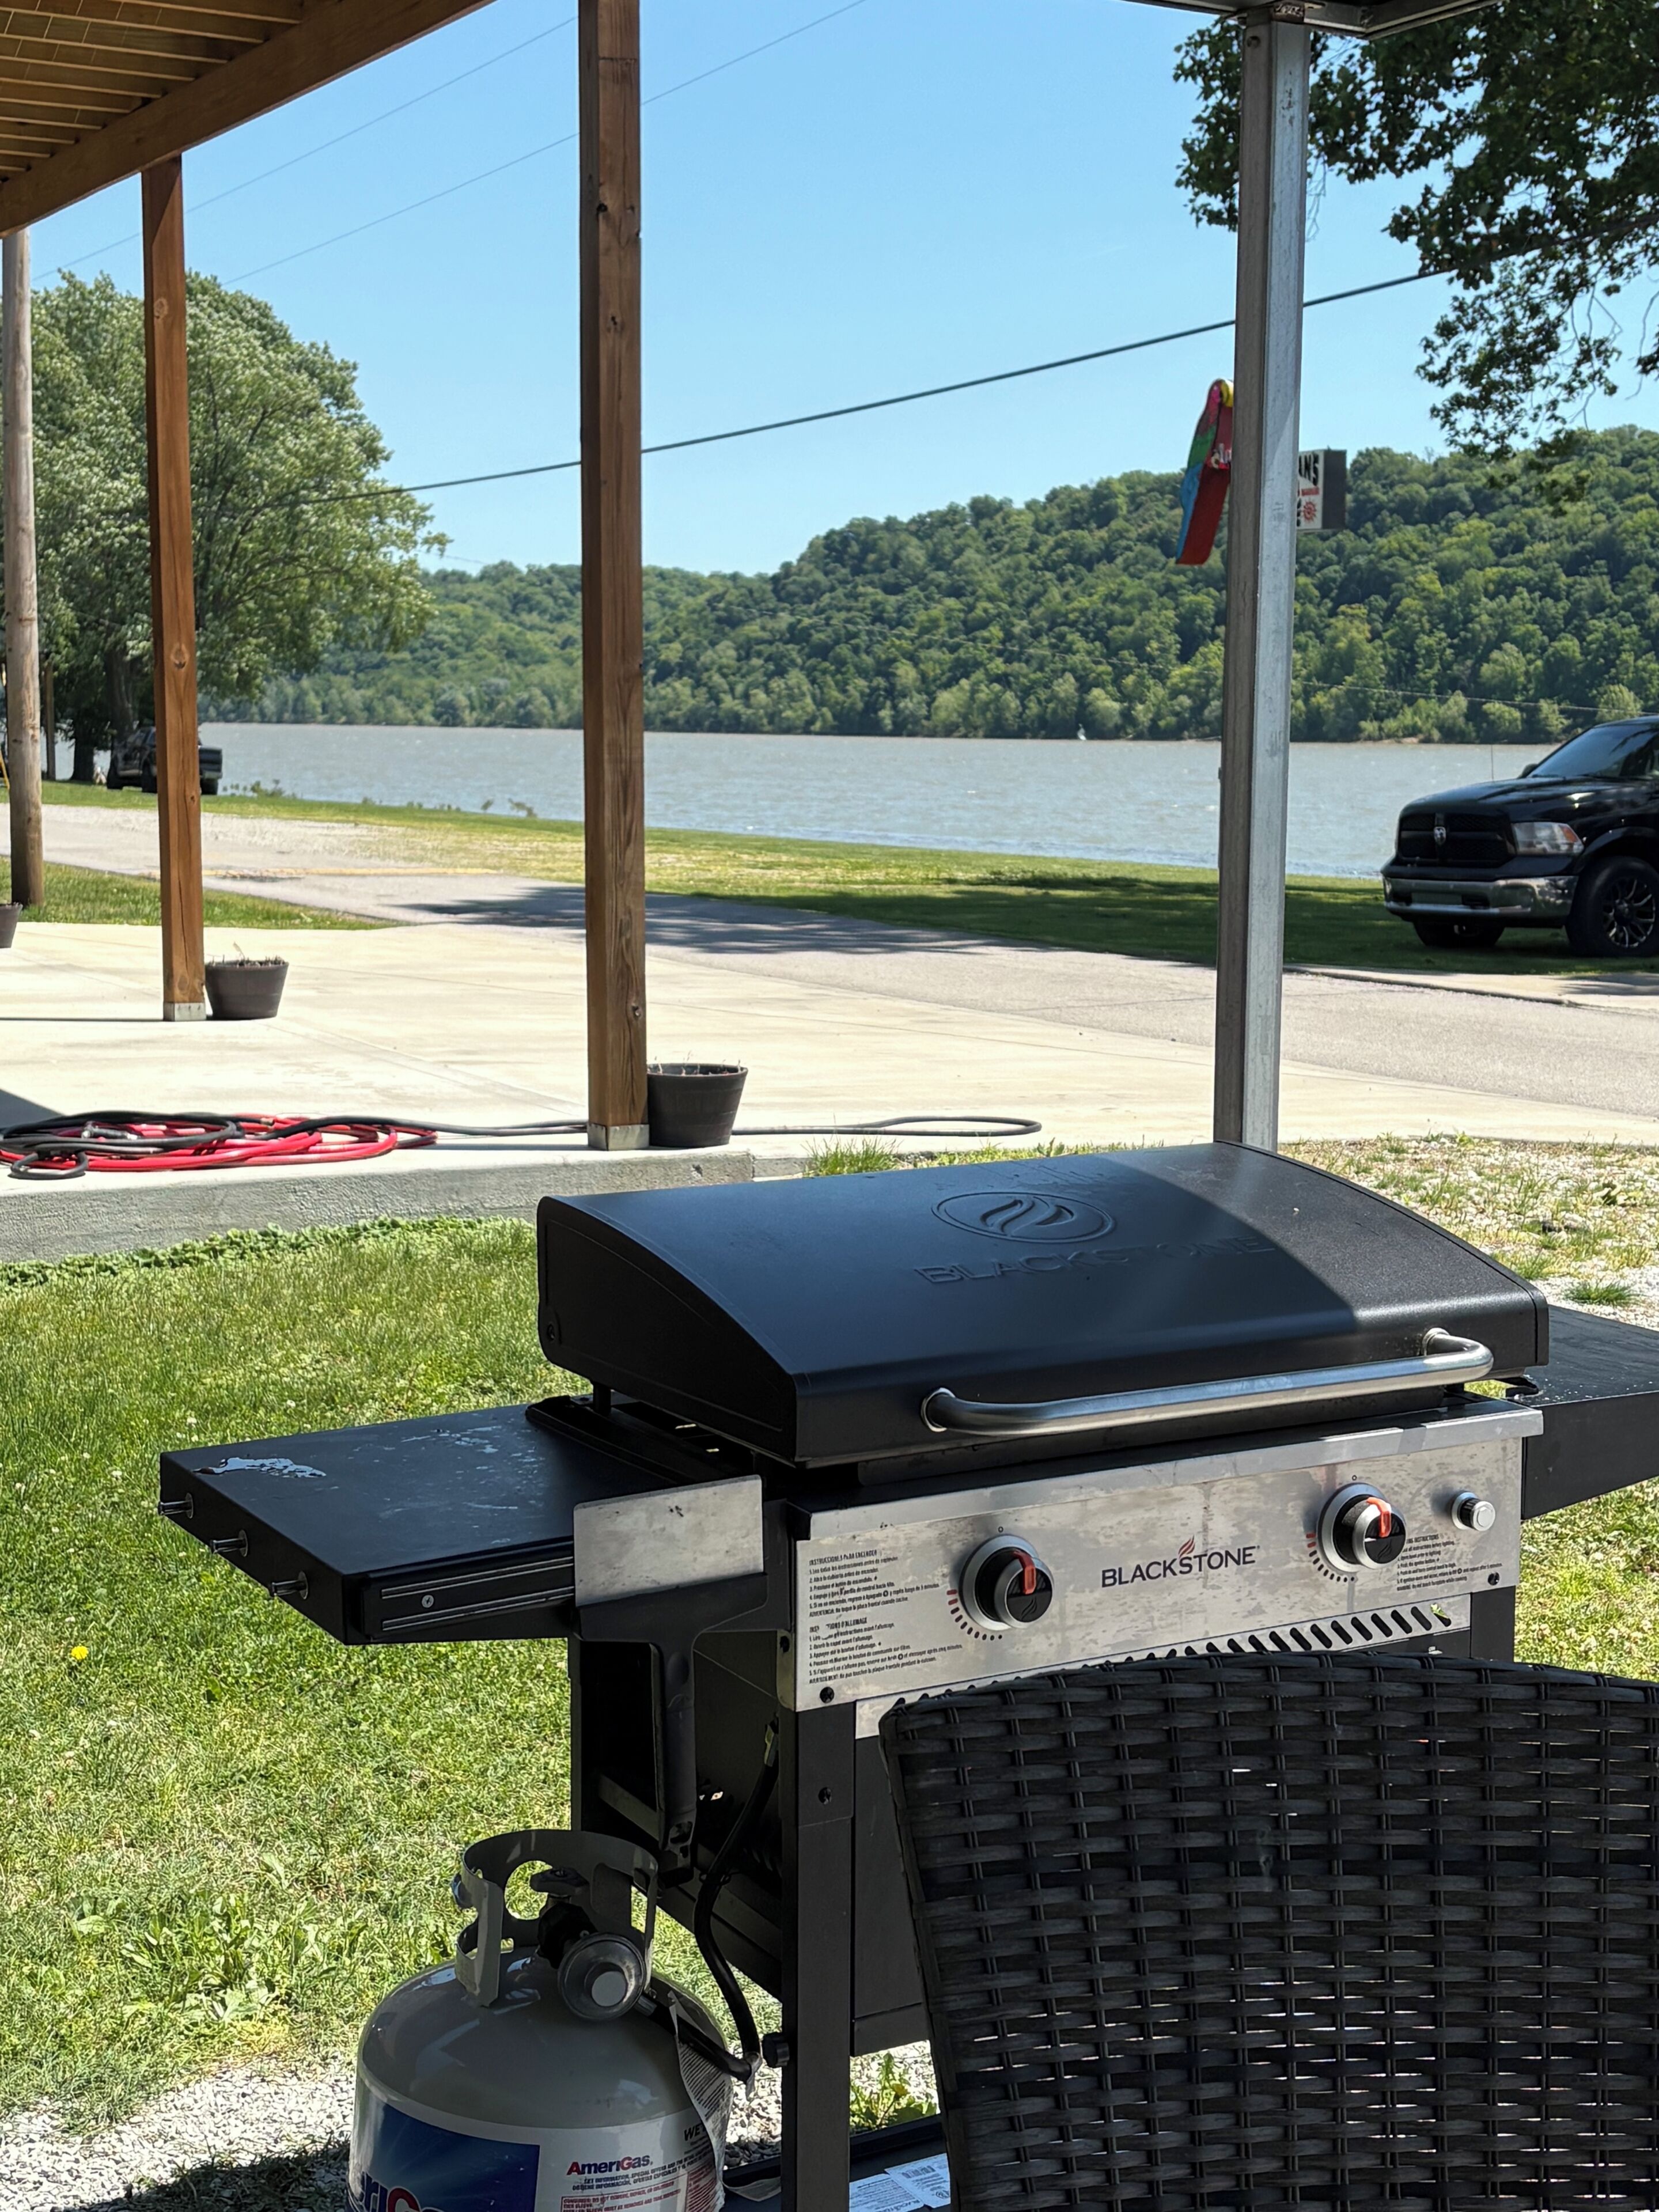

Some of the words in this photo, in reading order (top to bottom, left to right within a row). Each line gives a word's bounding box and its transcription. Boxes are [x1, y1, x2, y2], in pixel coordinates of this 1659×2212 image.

[915, 1236, 1275, 1283] BLACKSONE
[1102, 1546, 1256, 1588] BLACKSTONE
[567, 2155, 651, 2176] AmeriGas
